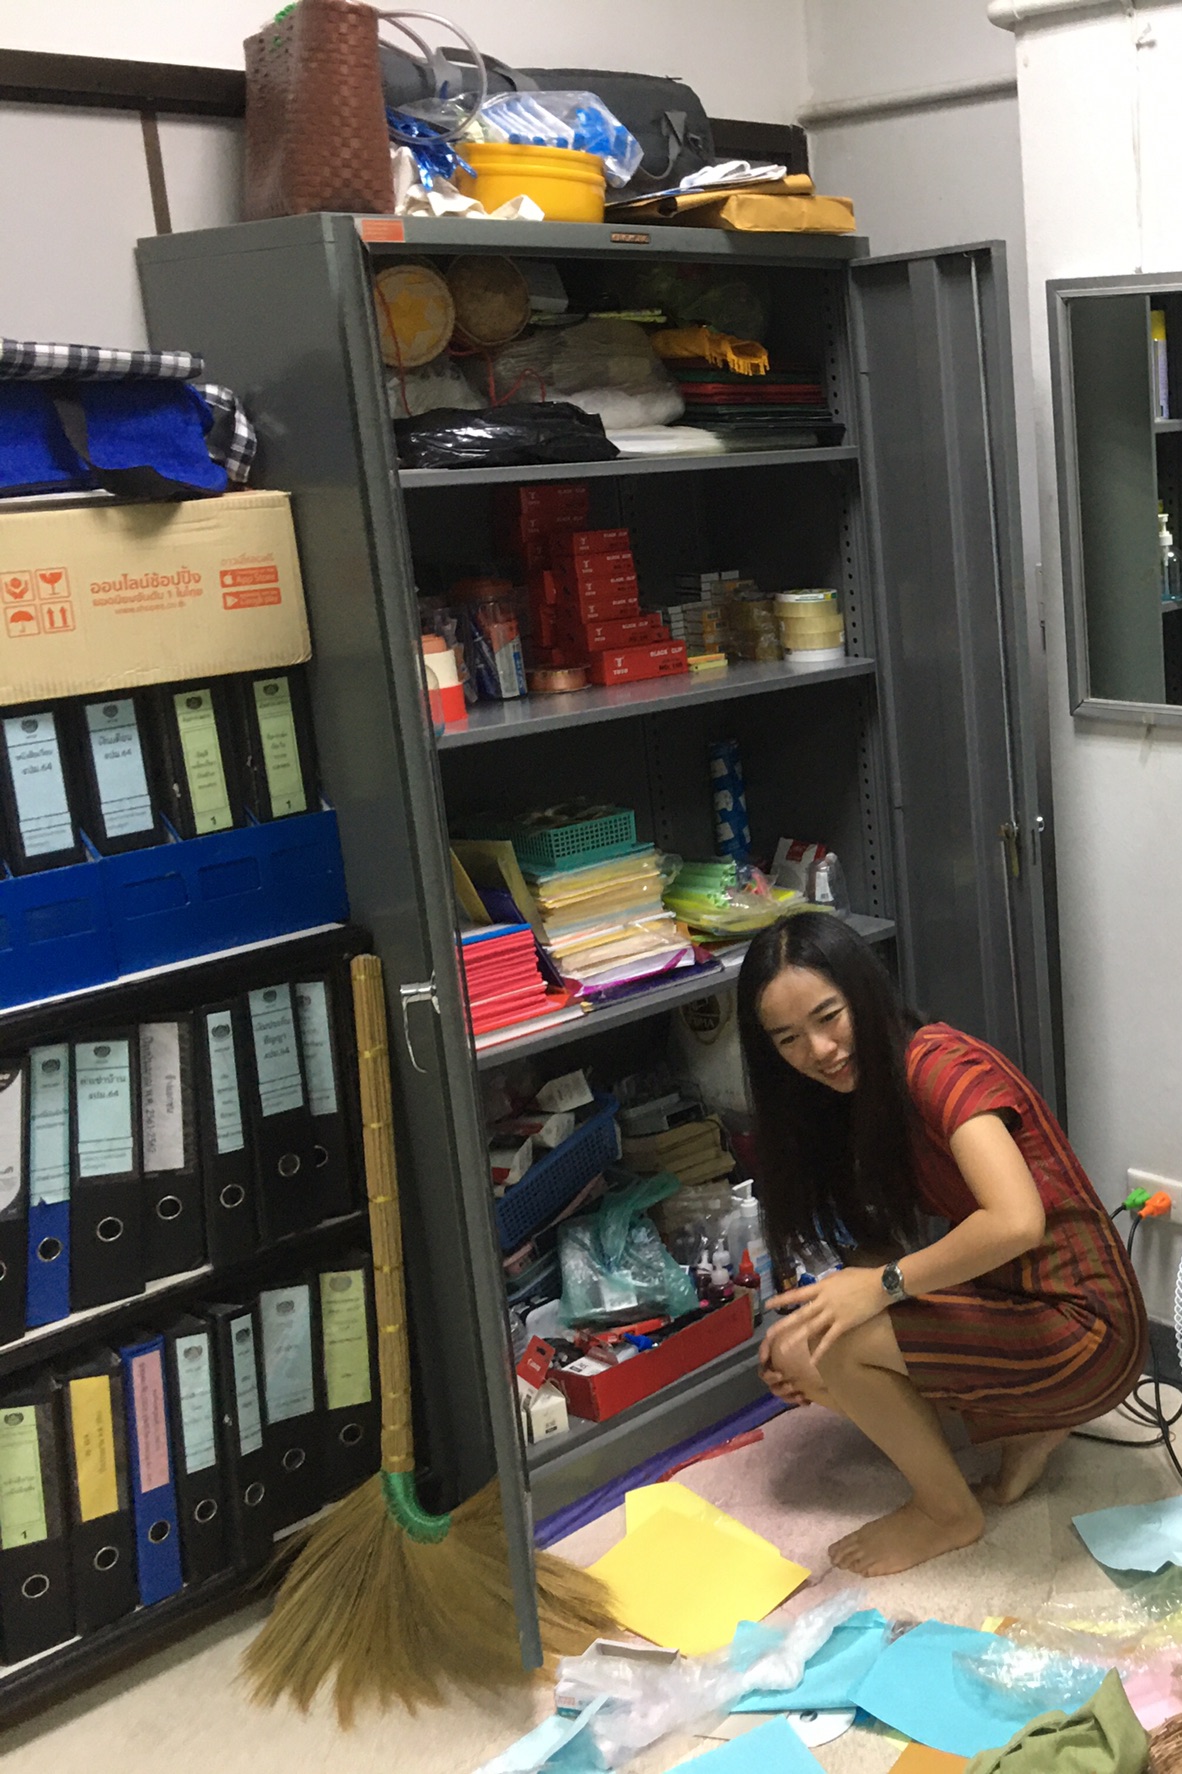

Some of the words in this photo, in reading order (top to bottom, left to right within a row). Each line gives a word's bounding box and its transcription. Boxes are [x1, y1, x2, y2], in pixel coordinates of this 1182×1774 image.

[89, 565, 203, 594] ออนไลน์ช้อปปิ้ง
